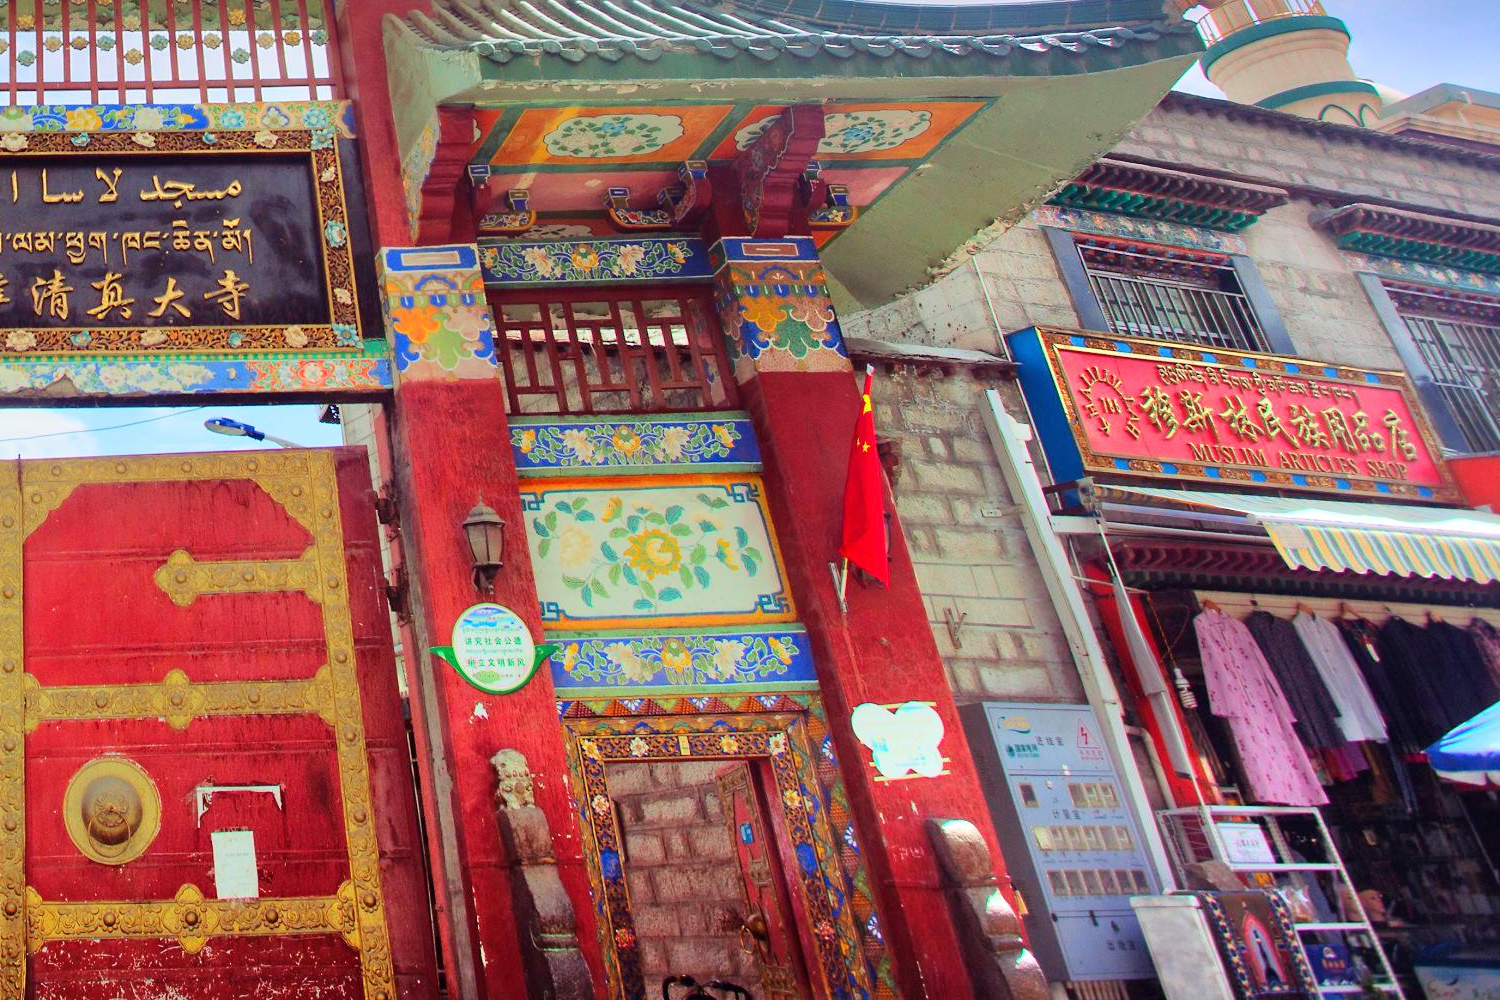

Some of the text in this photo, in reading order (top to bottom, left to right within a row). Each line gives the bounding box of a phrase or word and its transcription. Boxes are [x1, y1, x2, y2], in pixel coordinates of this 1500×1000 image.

[140, 174, 242, 209] مسجد
[1139, 385, 1418, 461] 穆斯林民族用品店
[1188, 441, 1408, 481] MUSLIM ARTICLES SHOP
